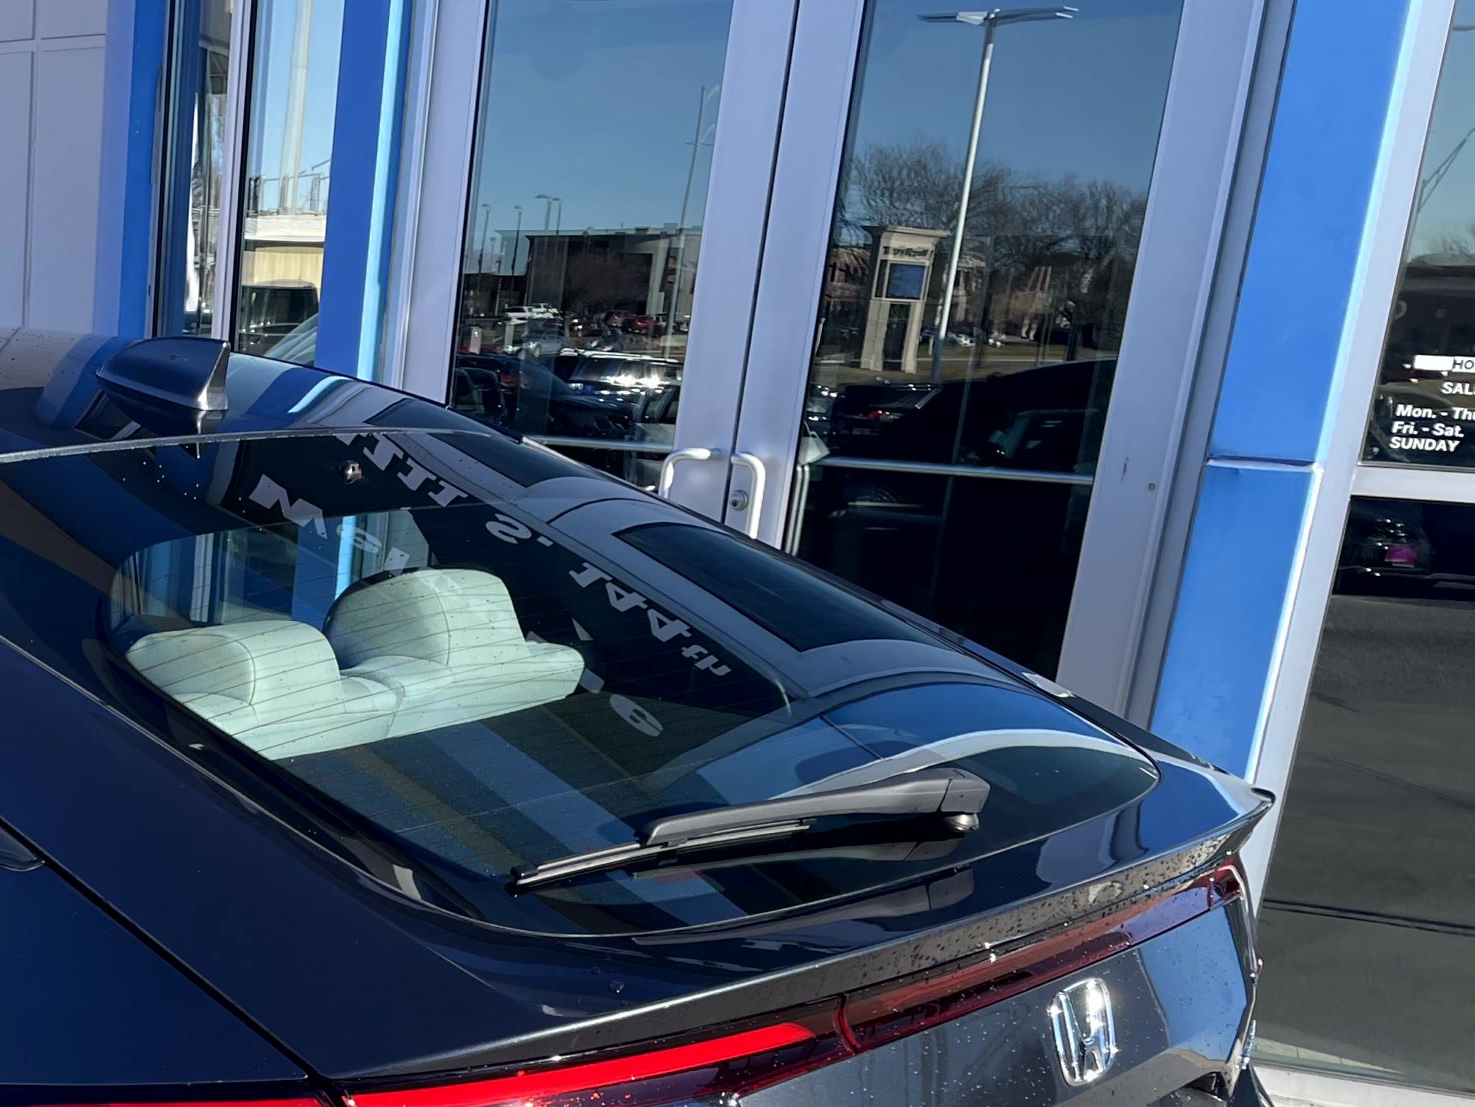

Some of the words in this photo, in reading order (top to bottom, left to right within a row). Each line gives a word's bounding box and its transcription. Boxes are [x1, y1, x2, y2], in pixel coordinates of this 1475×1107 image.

[1396, 404, 1437, 418] Mon.
[1392, 421, 1418, 435] Fri.
[1432, 423, 1464, 437] Sat.
[1389, 436, 1460, 452] SUNDAY
